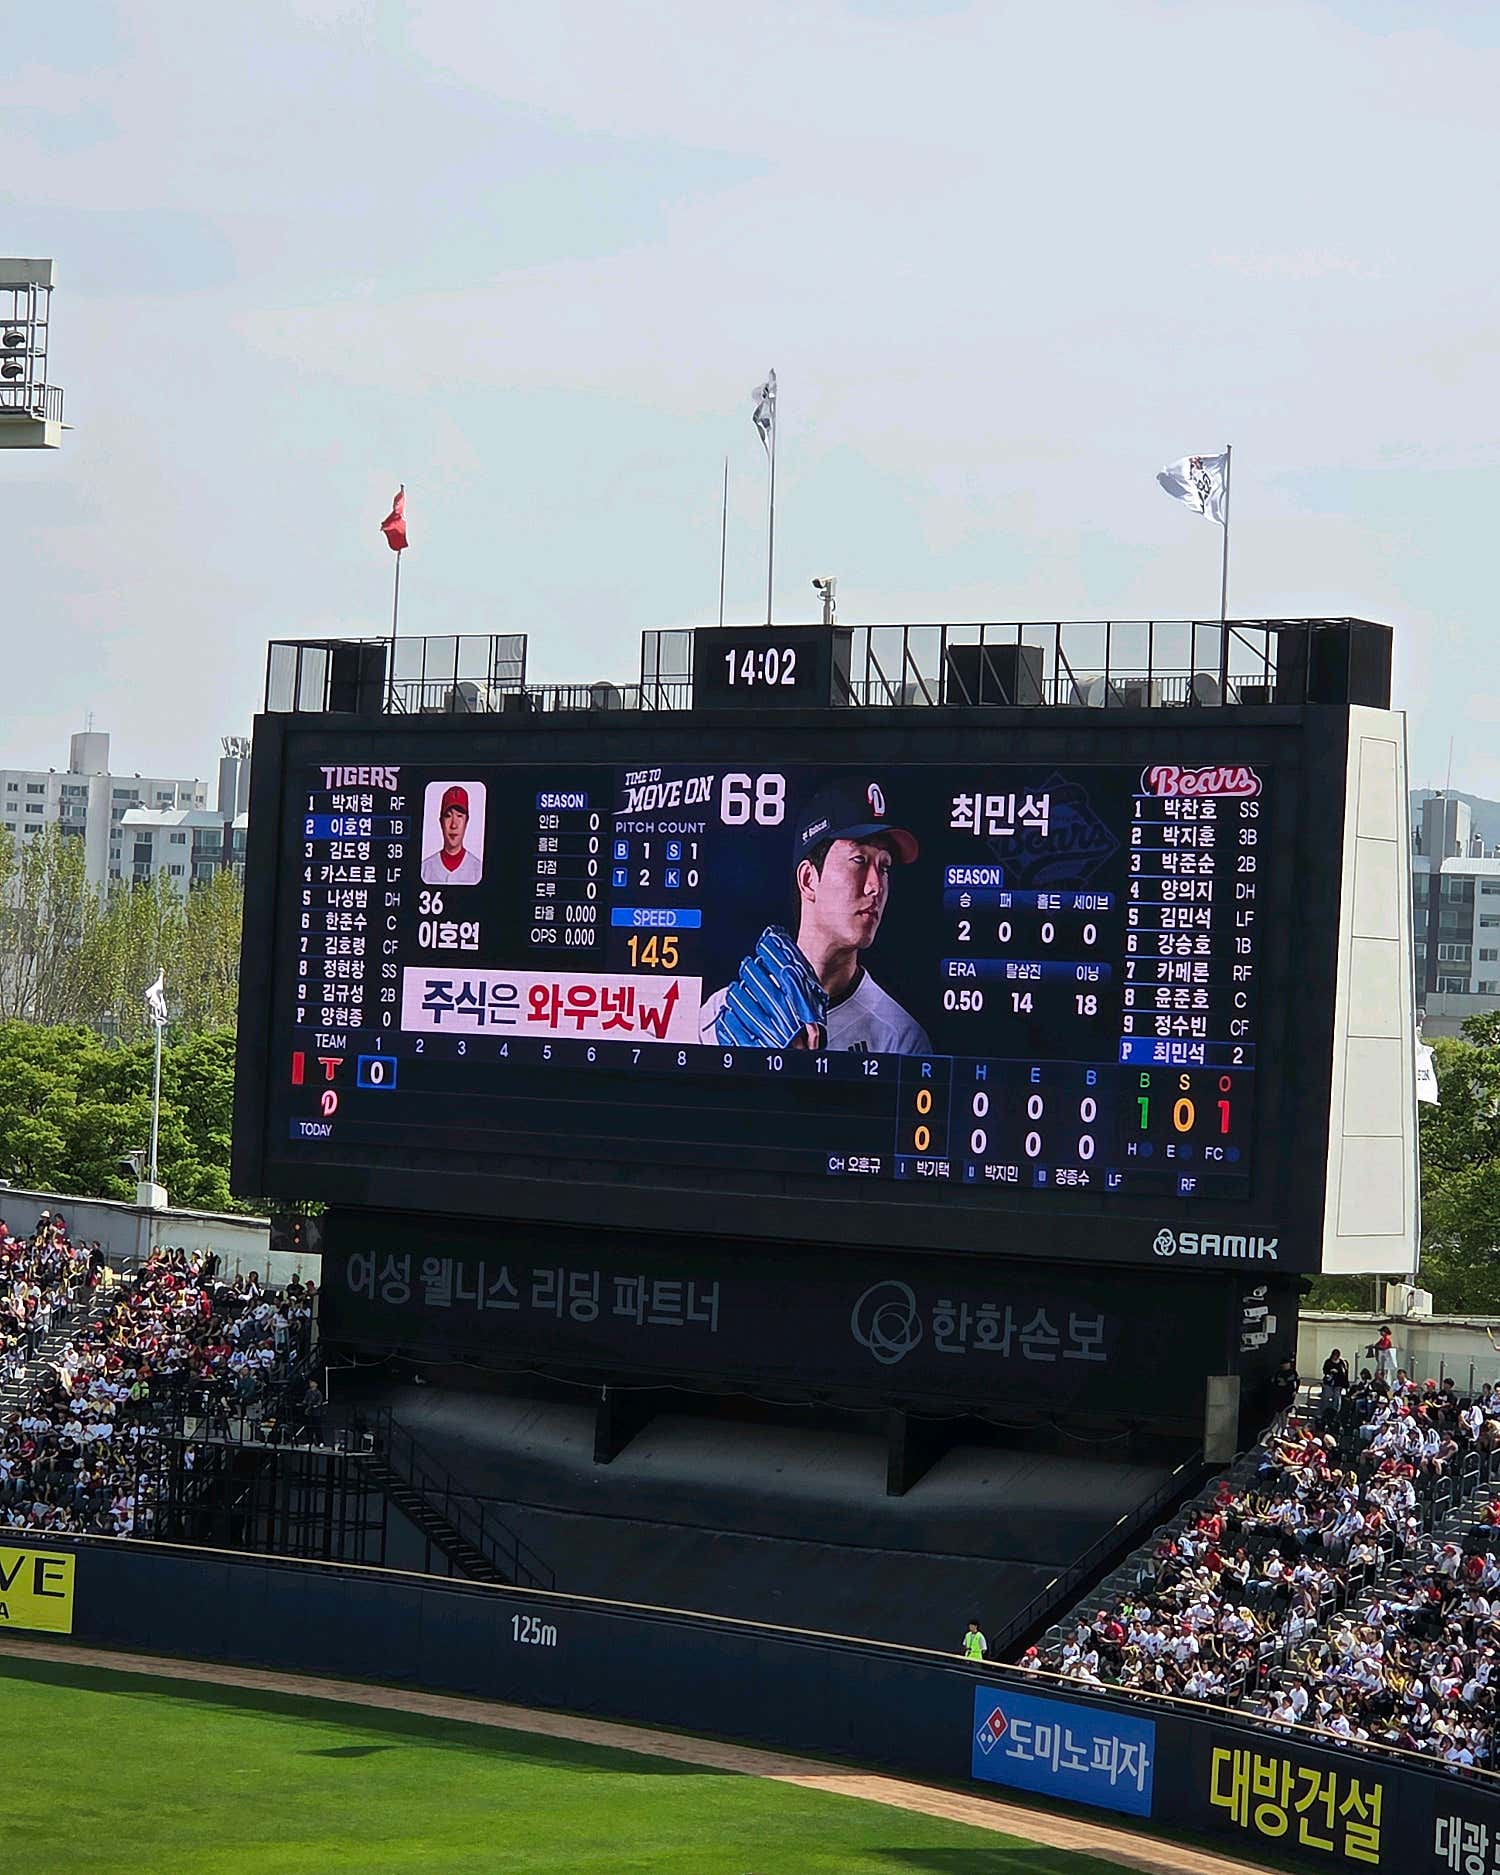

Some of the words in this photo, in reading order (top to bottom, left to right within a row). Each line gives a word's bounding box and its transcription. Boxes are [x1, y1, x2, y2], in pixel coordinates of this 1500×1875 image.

[725, 648, 796, 685] 14:02
[320, 766, 400, 790] TIGERS
[625, 770, 647, 786] TIME
[648, 768, 661, 781] TO
[1150, 766, 1257, 797] Bears
[332, 794, 373, 812] 박재현
[390, 797, 405, 811] RF
[540, 793, 584, 808] SEASON
[619, 780, 683, 814] MOVE
[684, 775, 714, 805] ON
[720, 773, 786, 825] 68
[950, 793, 1050, 836] 최민석
[1134, 801, 1141, 818] 1
[1164, 799, 1217, 820] 박찬호
[1239, 802, 1259, 818] SS
[330, 818, 372, 836] 이호연
[390, 820, 403, 834] 1B
[539, 814, 559, 829] 안타
[590, 813, 599, 831] 0
[615, 822, 655, 833] PITCH
[658, 822, 706, 834] COUNT
[589, 836, 598, 854] 0
[1132, 828, 1141, 845] 2
[1163, 826, 1216, 847] 박지훈
[1238, 829, 1257, 845] 3B
[329, 841, 370, 860] 김도영
[387, 844, 403, 858] 3B
[537, 860, 557, 875] 타점
[587, 859, 597, 877] 0
[1131, 854, 1141, 872] 3
[1162, 853, 1215, 874] 박준순
[1237, 856, 1256, 872] 2B
[320, 865, 376, 883] 카스트로
[387, 868, 401, 882] LF
[639, 869, 650, 886] 2
[688, 870, 698, 887] 0
[948, 868, 1000, 885] SEASON
[327, 889, 367, 908] 나성범
[385, 892, 400, 906] DH
[536, 883, 556, 898] 도루
[587, 882, 597, 900] 0
[1130, 881, 1139, 899] 4
[1161, 880, 1213, 901] 양의지
[1236, 883, 1255, 900] DH
[418, 891, 444, 914] 36
[959, 892, 971, 908] 승
[1073, 894, 1109, 911] 세이브
[325, 911, 367, 931] 한준수
[386, 915, 397, 930] C
[566, 905, 597, 923] 0.000
[633, 909, 676, 926] SPEED
[1128, 908, 1138, 926] 5
[1160, 907, 1211, 929] 김민석
[1236, 911, 1254, 927] LF
[418, 921, 480, 950] 이호연
[531, 928, 557, 943] OPS
[565, 928, 595, 946] 0.000
[958, 921, 971, 941] 2
[998, 922, 1012, 942] 0
[1041, 922, 1055, 943] 0
[1083, 924, 1097, 945] 0
[325, 936, 365, 955] 김호령
[383, 940, 399, 954] CF
[627, 935, 679, 969] 145
[1127, 934, 1137, 952] 6
[1158, 934, 1211, 955] 강승호
[1235, 937, 1252, 954] 1B
[324, 959, 365, 979] 정현창
[382, 963, 397, 978] SS
[949, 962, 976, 977] ERA
[1006, 963, 1041, 980] 탈삼진
[1076, 965, 1099, 982] 이닝
[1126, 962, 1136, 979] 7
[1157, 961, 1210, 983] 카메론
[1233, 965, 1252, 981] RF
[298, 984, 306, 999] 9
[322, 983, 363, 1003] 김규성
[380, 988, 396, 1002] 2B
[943, 989, 983, 1011] 0.50
[1011, 992, 1033, 1013] 14
[1075, 994, 1097, 1016] 18
[1125, 989, 1135, 1006] 8
[1154, 988, 1209, 1010] 윤준호
[1234, 992, 1247, 1008] C
[421, 979, 520, 1026] 주식은
[526, 983, 635, 1031] 와우넷
[297, 1007, 305, 1023] P
[321, 1007, 362, 1027] 양현종
[383, 1011, 391, 1027] 0
[1124, 1015, 1133, 1033] 9
[1154, 1015, 1207, 1038] 정수빈
[1230, 1019, 1249, 1036] CF
[315, 1033, 346, 1049] TEAM
[416, 1038, 424, 1053] 2
[457, 1040, 466, 1055] 3
[500, 1043, 508, 1058] 4
[543, 1045, 551, 1060] 5
[587, 1047, 596, 1061] 6
[632, 1049, 641, 1064] 7
[678, 1050, 686, 1066] 8
[723, 1053, 733, 1068] 9
[766, 1055, 783, 1071] 10
[816, 1058, 828, 1073] 11
[862, 1060, 879, 1076] 12
[921, 1062, 932, 1078] R
[976, 1065, 987, 1080] H
[1031, 1067, 1041, 1083] E
[1086, 1070, 1097, 1085] B
[1122, 1043, 1132, 1060] P
[1153, 1042, 1205, 1064] 최민석
[1233, 1047, 1243, 1064] 2
[318, 1057, 344, 1081] T
[370, 1061, 384, 1084] 0
[916, 1089, 932, 1115] 0
[972, 1091, 989, 1117] 0
[1027, 1094, 1043, 1120] 0
[1080, 1097, 1097, 1123] 0
[1140, 1072, 1150, 1088] B
[1179, 1074, 1191, 1090] S
[1137, 1097, 1149, 1129] 1
[1173, 1097, 1195, 1132] 0
[1217, 1100, 1230, 1133] 1
[300, 1123, 332, 1137] TODAY
[914, 1125, 930, 1151] 0
[970, 1128, 987, 1154] 0
[1025, 1131, 1041, 1157] 0
[1078, 1134, 1095, 1160] 0
[1128, 1143, 1137, 1156] H
[1166, 1145, 1176, 1158] E
[1205, 1147, 1223, 1160] FC
[829, 1157, 845, 1170] CH
[917, 1161, 950, 1177] 박기택
[985, 1164, 1018, 1182] 박지민
[1055, 1169, 1090, 1186] 정종수
[1108, 1174, 1122, 1187] LF
[1181, 1178, 1197, 1191] RF
[1179, 1232, 1279, 1260] SAMIK
[346, 1250, 412, 1304] 여성
[420, 1255, 520, 1311] 웰니스
[531, 1267, 601, 1322] 리딩
[612, 1275, 720, 1333] 파트너
[930, 1299, 1108, 1362] 한화손보
[511, 1614, 557, 1647] 125m
[1004, 1716, 1151, 1793] 도미노피자
[1209, 1746, 1385, 1866] 대방건설
